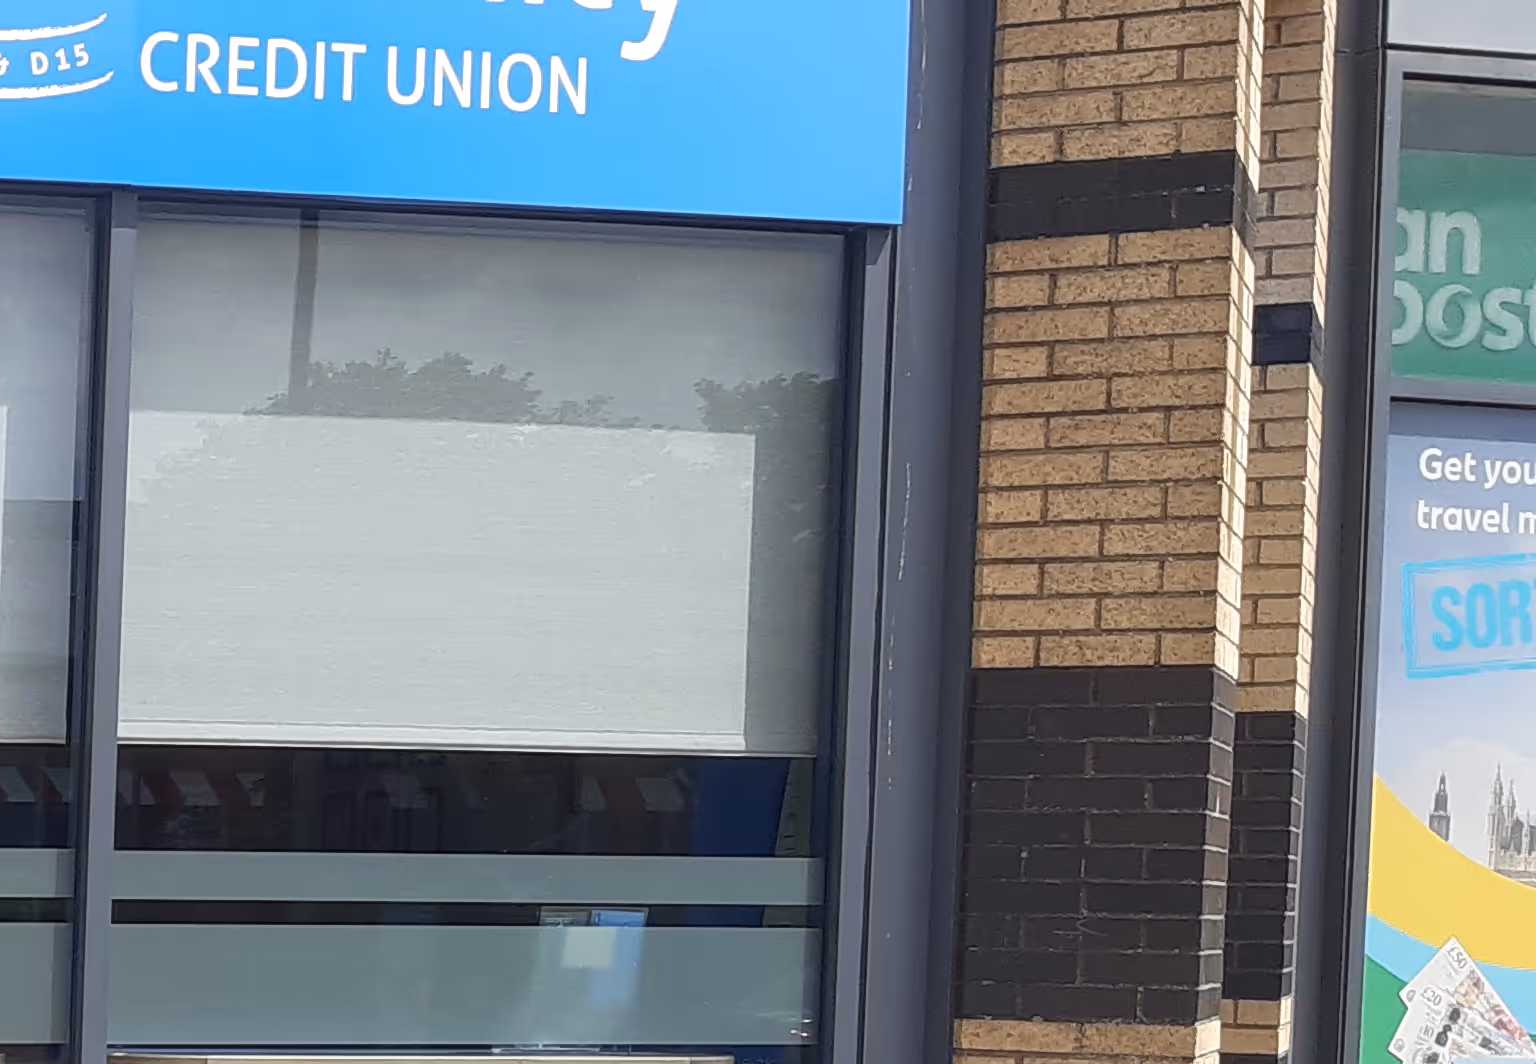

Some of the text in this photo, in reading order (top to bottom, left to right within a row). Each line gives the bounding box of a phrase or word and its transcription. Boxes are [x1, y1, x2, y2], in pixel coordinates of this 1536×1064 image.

[30, 43, 90, 76] D15
[140, 31, 587, 115] CREDIT UNION
[1419, 447, 1475, 483] Get
[1416, 500, 1509, 534] travel
[1431, 577, 1536, 652] SOR
